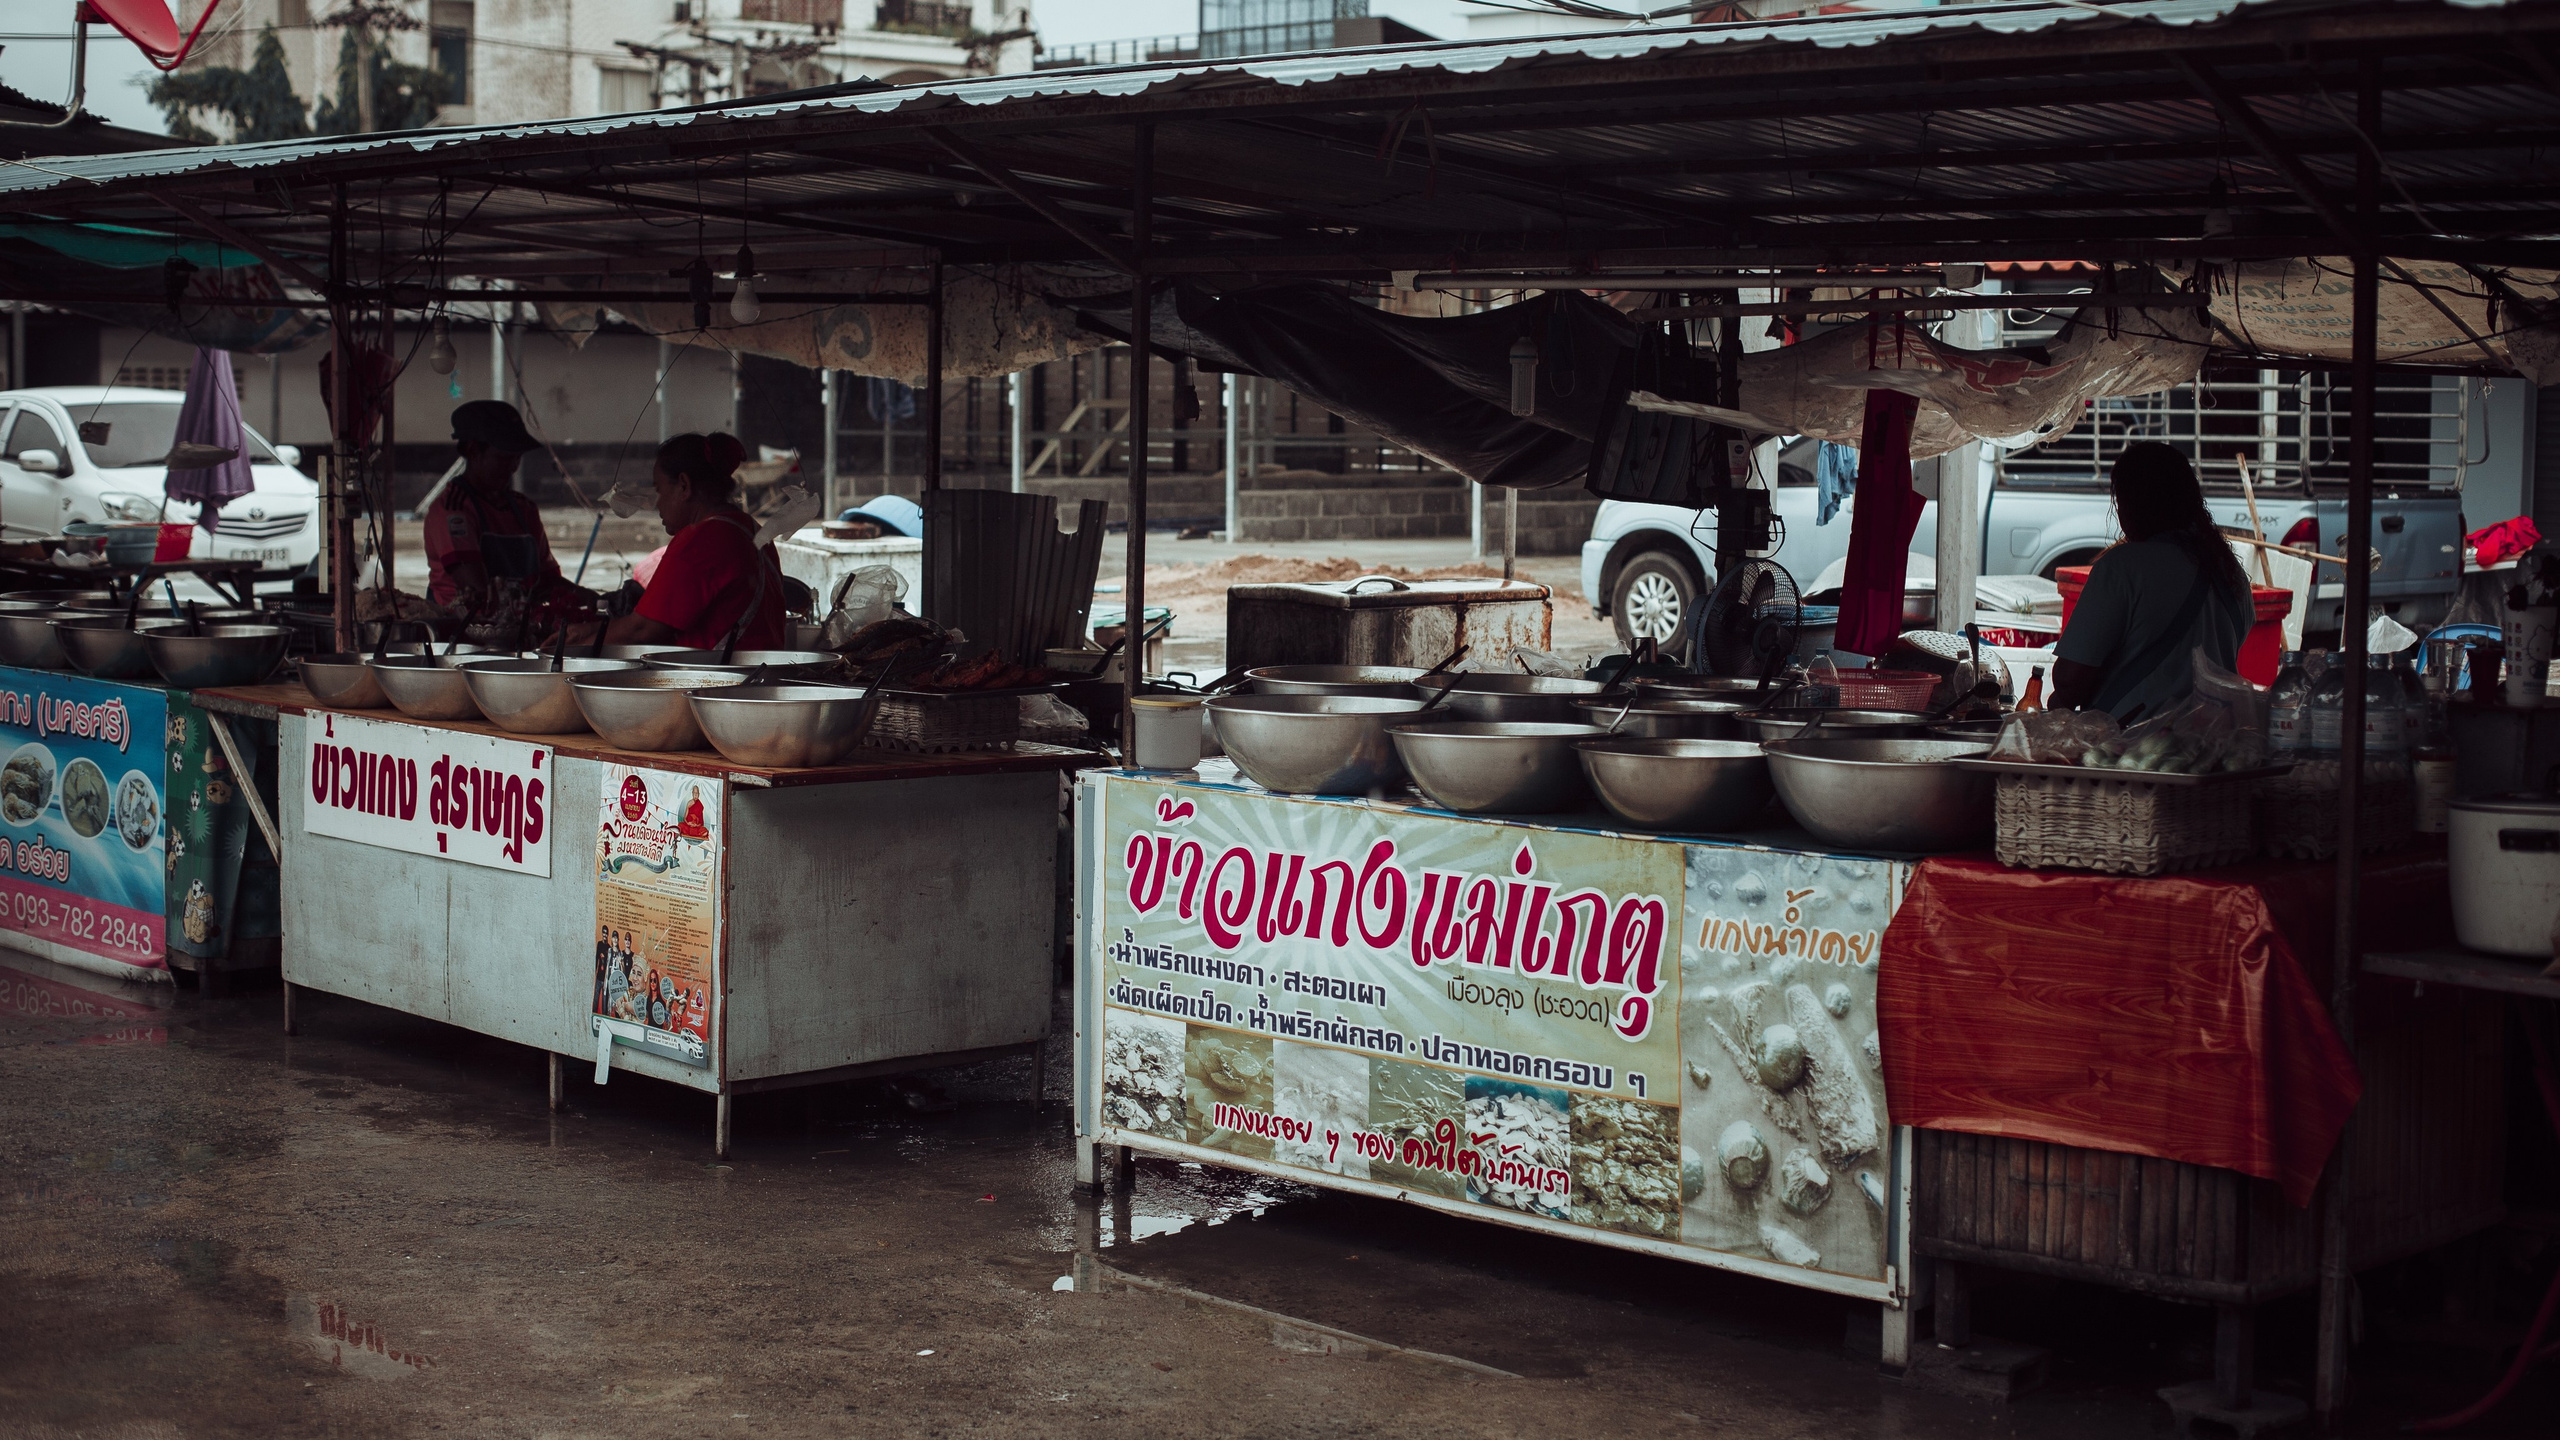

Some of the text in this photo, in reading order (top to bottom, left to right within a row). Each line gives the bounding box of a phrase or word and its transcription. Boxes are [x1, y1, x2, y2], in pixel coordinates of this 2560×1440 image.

[37, 691, 131, 753] (นครศรี)
[311, 714, 546, 864] ข้าวแกง สุราษฎร์
[16, 833, 70, 885] อร่อย
[14, 892, 95, 940] 093-782
[100, 914, 152, 956] 2843
[1283, 970, 1387, 1008] สะตอเผา
[1447, 975, 1611, 1029] เมืองลุง (ชะอวด)
[1248, 993, 1404, 1055] น้ำพริกผักสด
[1421, 1034, 1614, 1091] ปลาทอดกรอบ
[1352, 1131, 1396, 1162] ของ
